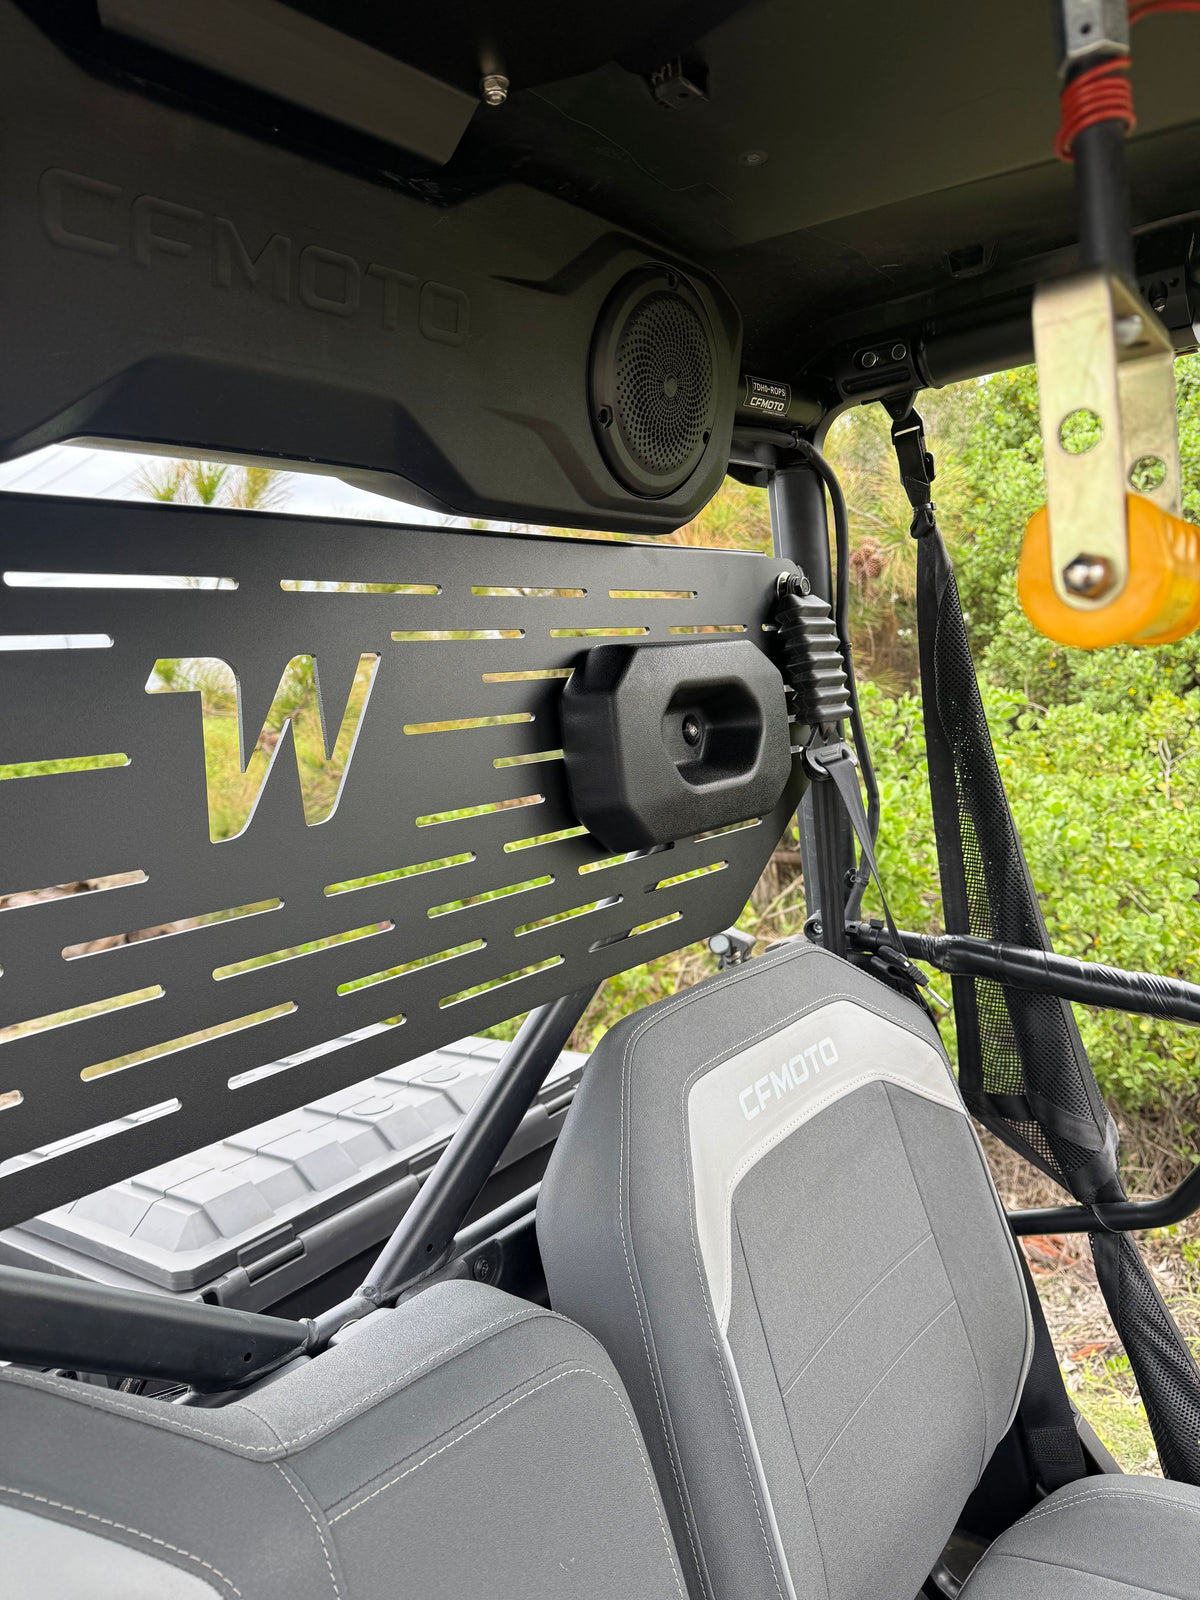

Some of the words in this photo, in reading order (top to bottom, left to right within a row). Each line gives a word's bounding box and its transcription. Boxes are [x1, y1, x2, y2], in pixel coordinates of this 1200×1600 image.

[39, 167, 470, 347] CFMOTO
[750, 397, 785, 411] CFMOTO
[738, 1036, 839, 1121] CFMOTO
